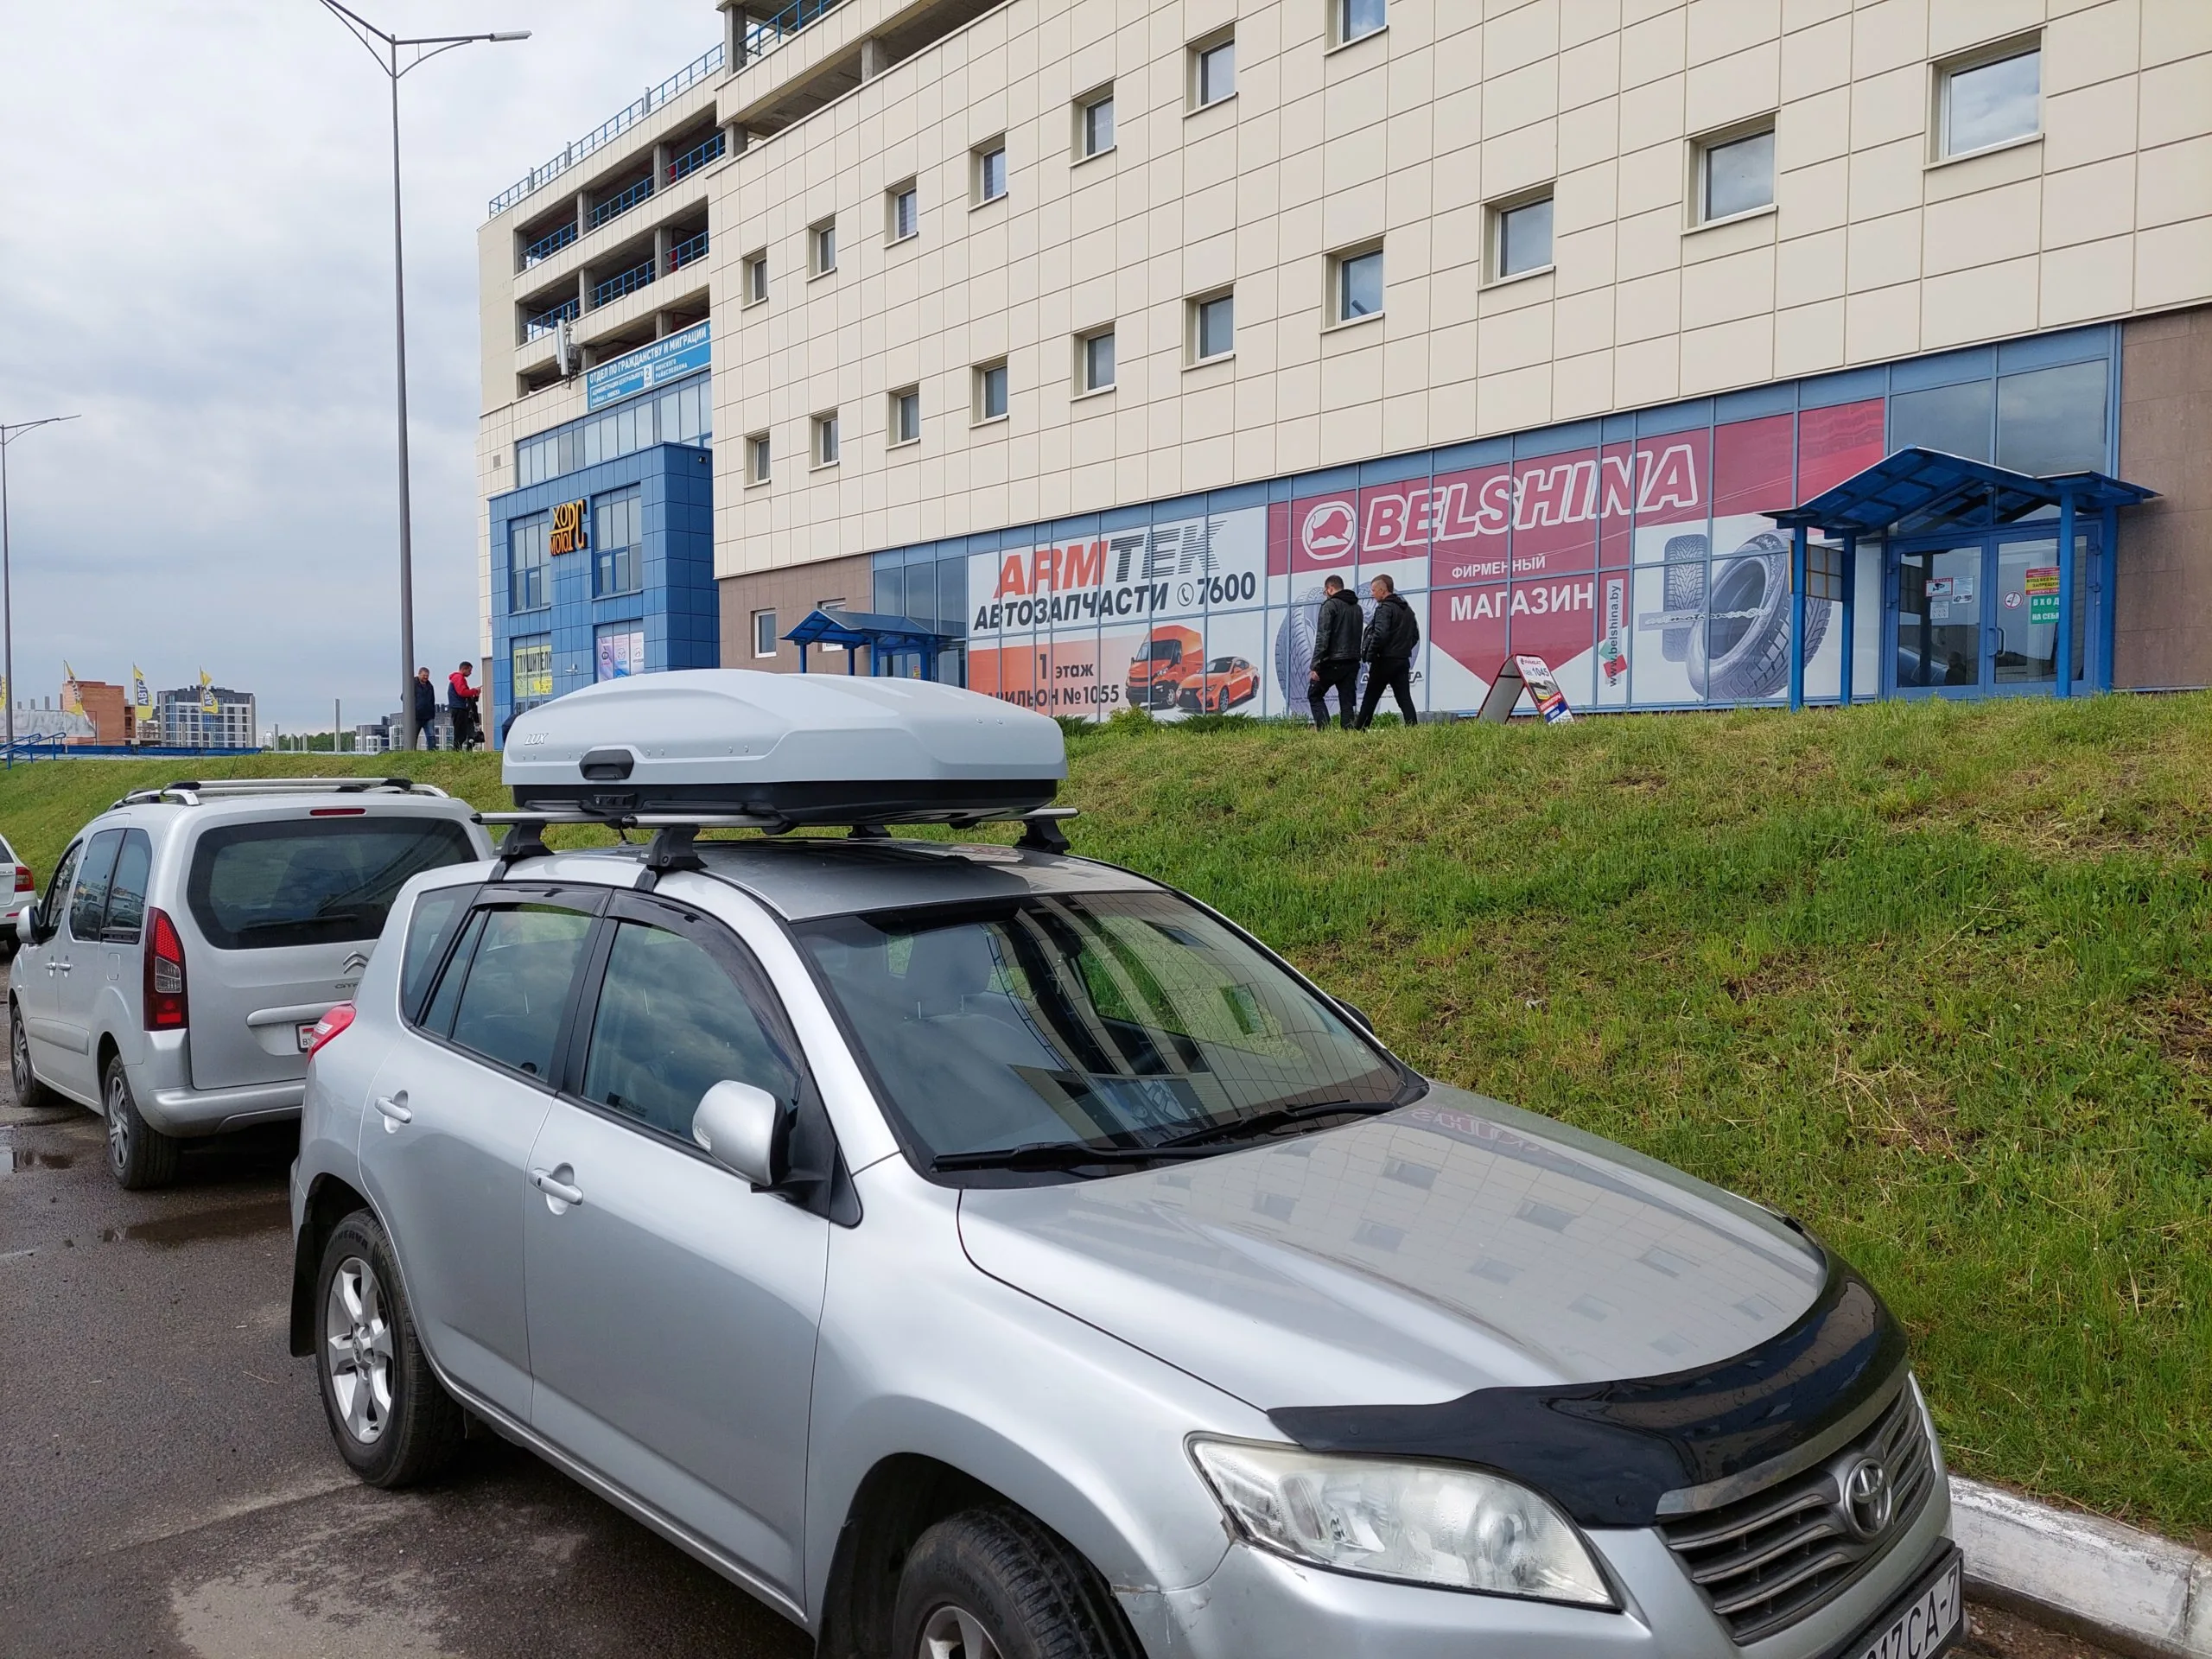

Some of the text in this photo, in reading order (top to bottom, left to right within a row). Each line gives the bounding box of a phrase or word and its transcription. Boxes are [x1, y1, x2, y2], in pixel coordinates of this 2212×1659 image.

[589, 367, 608, 384] ОТДЕЛ
[608, 364, 617, 375] ПО
[618, 344, 663, 372] ГРАЖДАНСТВУ
[664, 343, 669, 354] И
[670, 326, 707, 351] МИГРАЦИИ
[1363, 443, 1699, 552] BELSHINA
[993, 519, 1228, 599] ARMTEK
[1452, 553, 1547, 579] ФИРМЕННЫЙ
[974, 571, 1256, 631] АВТОЗАПЧАСТИ 7600
[1451, 582, 1594, 622] МАГАЗИН
[2033, 597, 2060, 607] ВХОД
[1608, 585, 1622, 688] www.belshina.by
[1039, 653, 1094, 680] 1 этаж
[1532, 666, 1549, 677] 1045
[524, 733, 549, 746] LUX
[1866, 1565, 1958, 1659] 17CA-7
